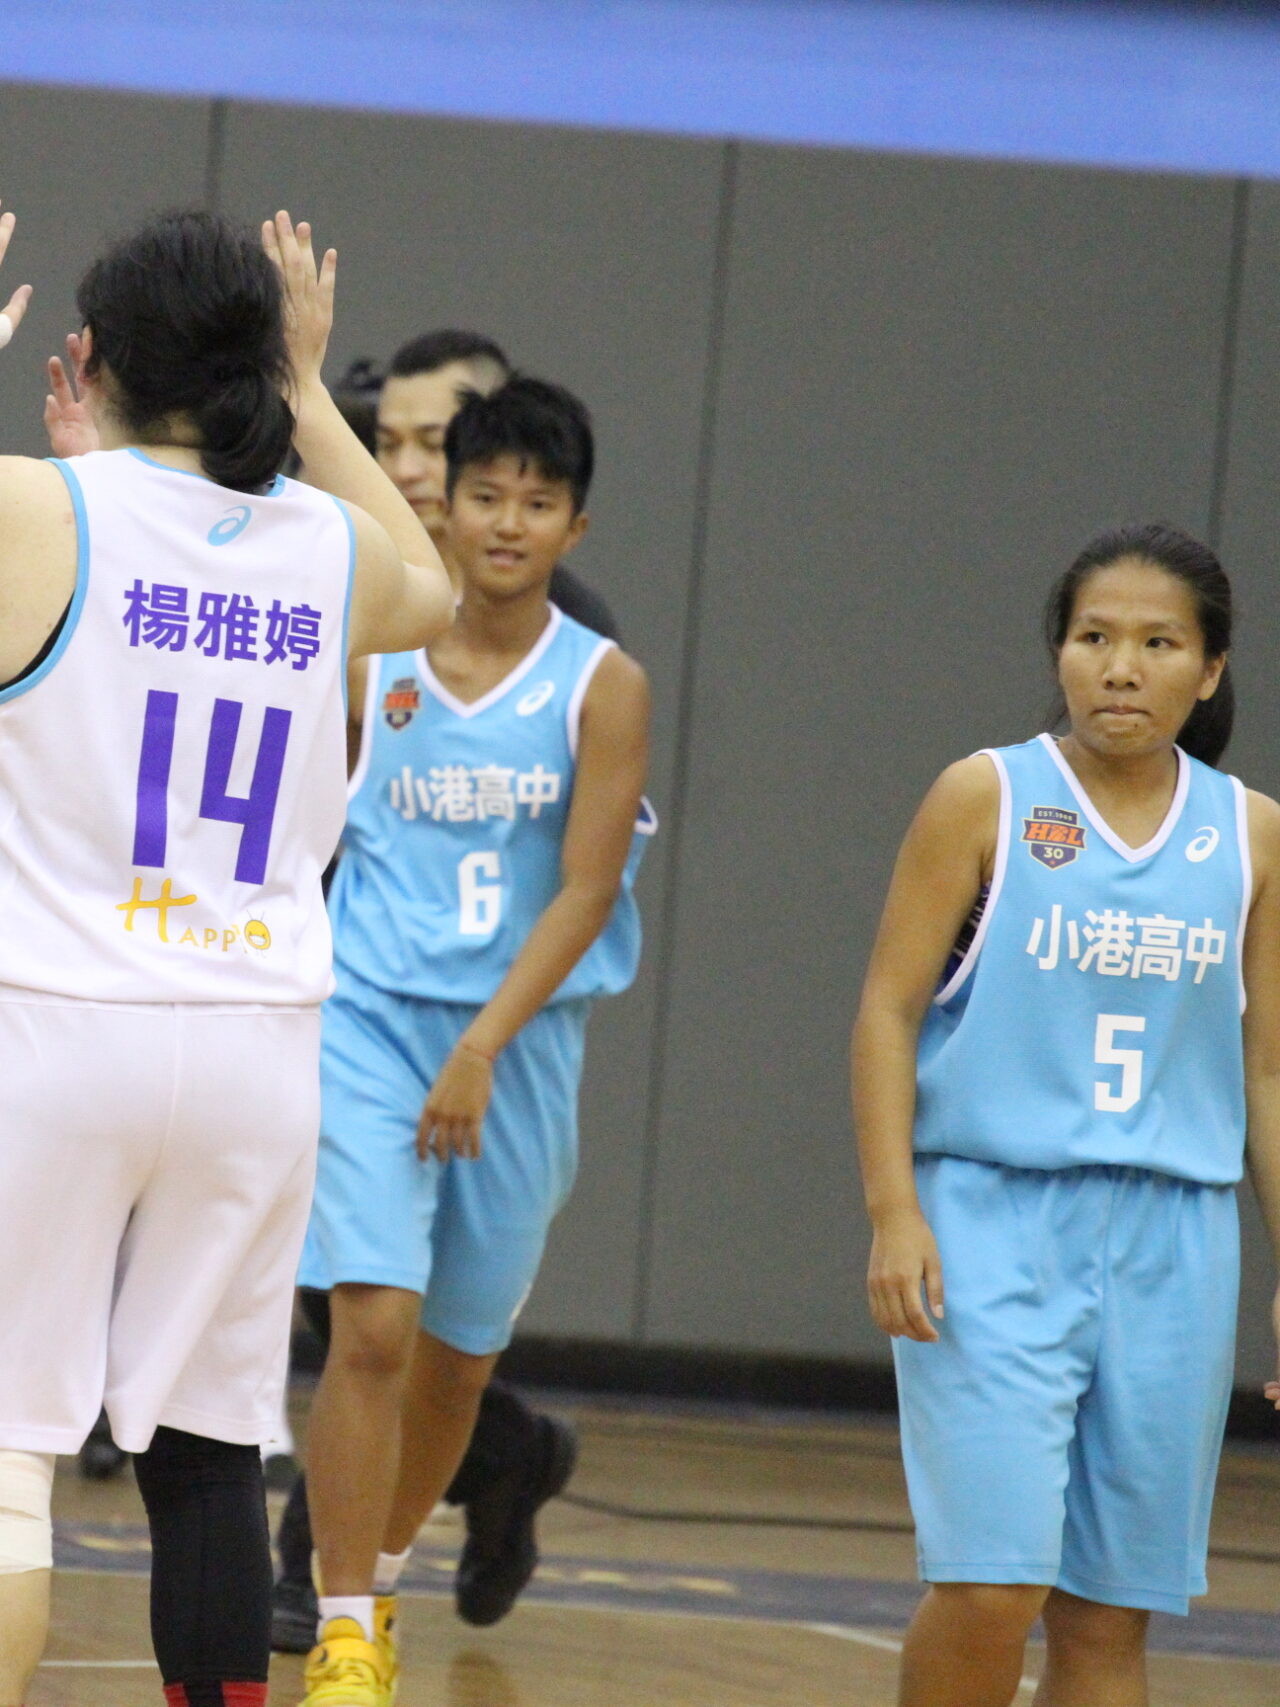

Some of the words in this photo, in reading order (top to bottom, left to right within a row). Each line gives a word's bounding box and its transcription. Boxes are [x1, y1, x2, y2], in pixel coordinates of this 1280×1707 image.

[123, 579, 322, 672] 楊雅婷
[131, 688, 293, 886] 14
[390, 764, 561, 822] 小港高中
[1026, 822, 1083, 846] HBL
[1043, 846, 1064, 860] 30
[458, 851, 501, 935] 6
[1025, 904, 1227, 984] 小港高中
[1094, 1014, 1146, 1113] 5
